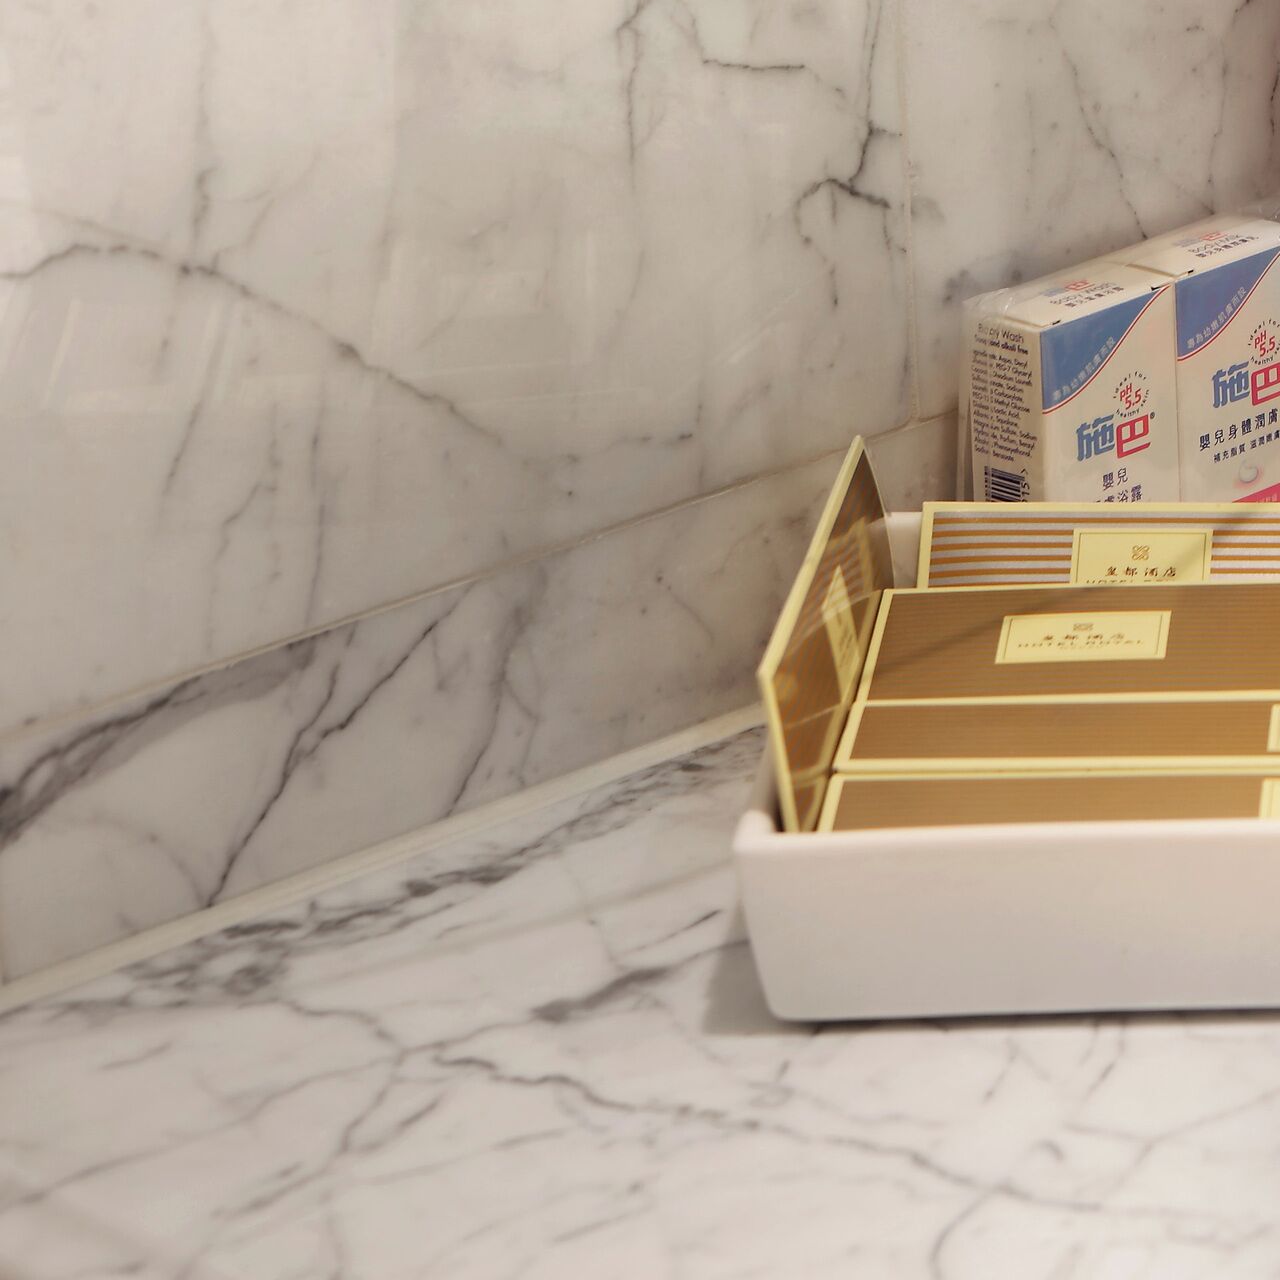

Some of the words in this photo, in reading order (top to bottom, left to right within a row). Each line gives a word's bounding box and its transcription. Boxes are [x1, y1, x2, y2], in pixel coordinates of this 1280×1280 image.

[1002, 329, 1024, 343] Wash
[1260, 335, 1275, 357] 5.5
[1125, 388, 1141, 410] 5.5
[1075, 414, 1150, 462] 施巴
[1103, 467, 1128, 490] 嬰兒
